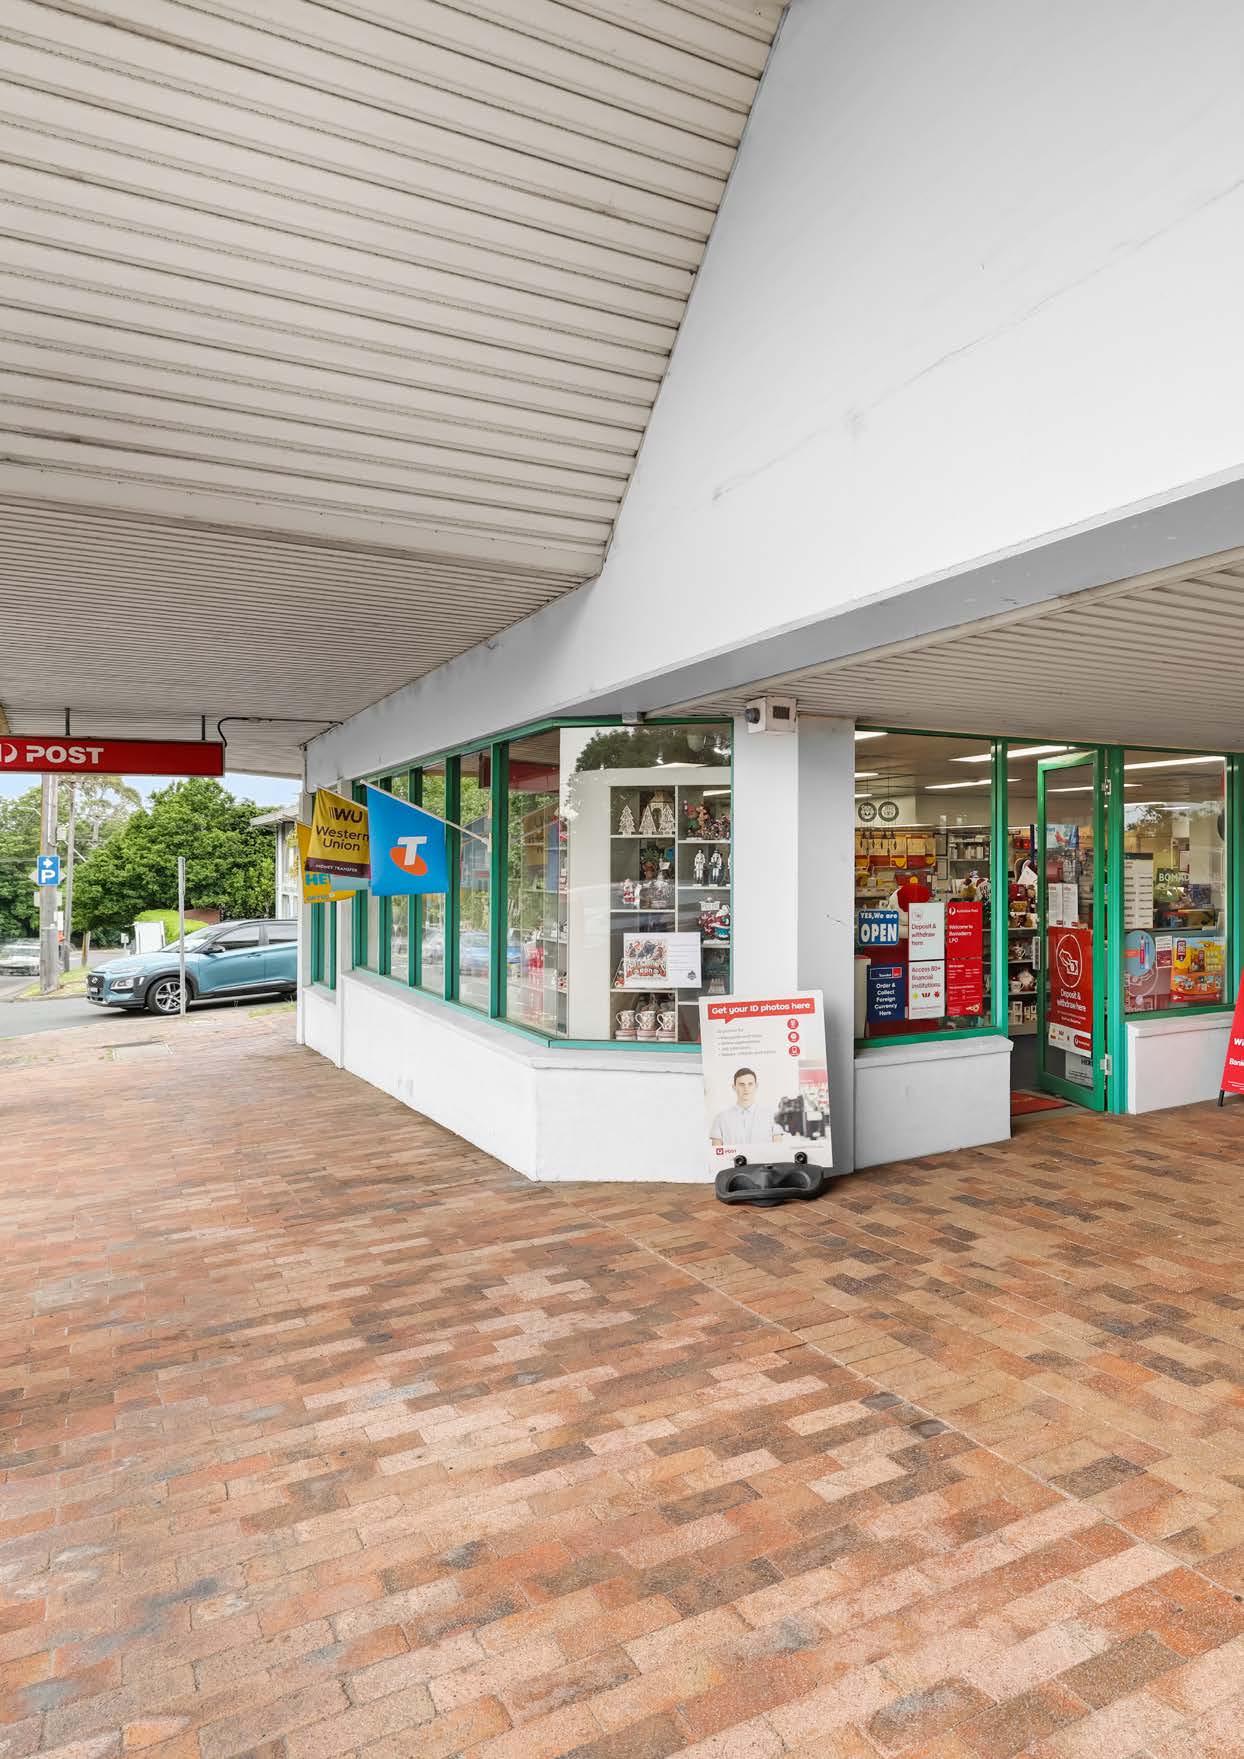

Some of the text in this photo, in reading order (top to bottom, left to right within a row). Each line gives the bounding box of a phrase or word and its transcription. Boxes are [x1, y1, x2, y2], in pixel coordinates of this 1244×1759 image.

[26, 745, 104, 764] POST
[331, 806, 363, 823] WU
[316, 825, 370, 842] Western
[323, 838, 360, 851] Union
[397, 836, 427, 866] T
[41, 869, 56, 884] P
[861, 923, 897, 943] OPEN
[1060, 988, 1077, 999] Deposit
[711, 1007, 727, 1015] Get
[729, 1005, 748, 1015] your
[760, 1003, 790, 1012] photos
[1056, 999, 1087, 1012] withdraw here
